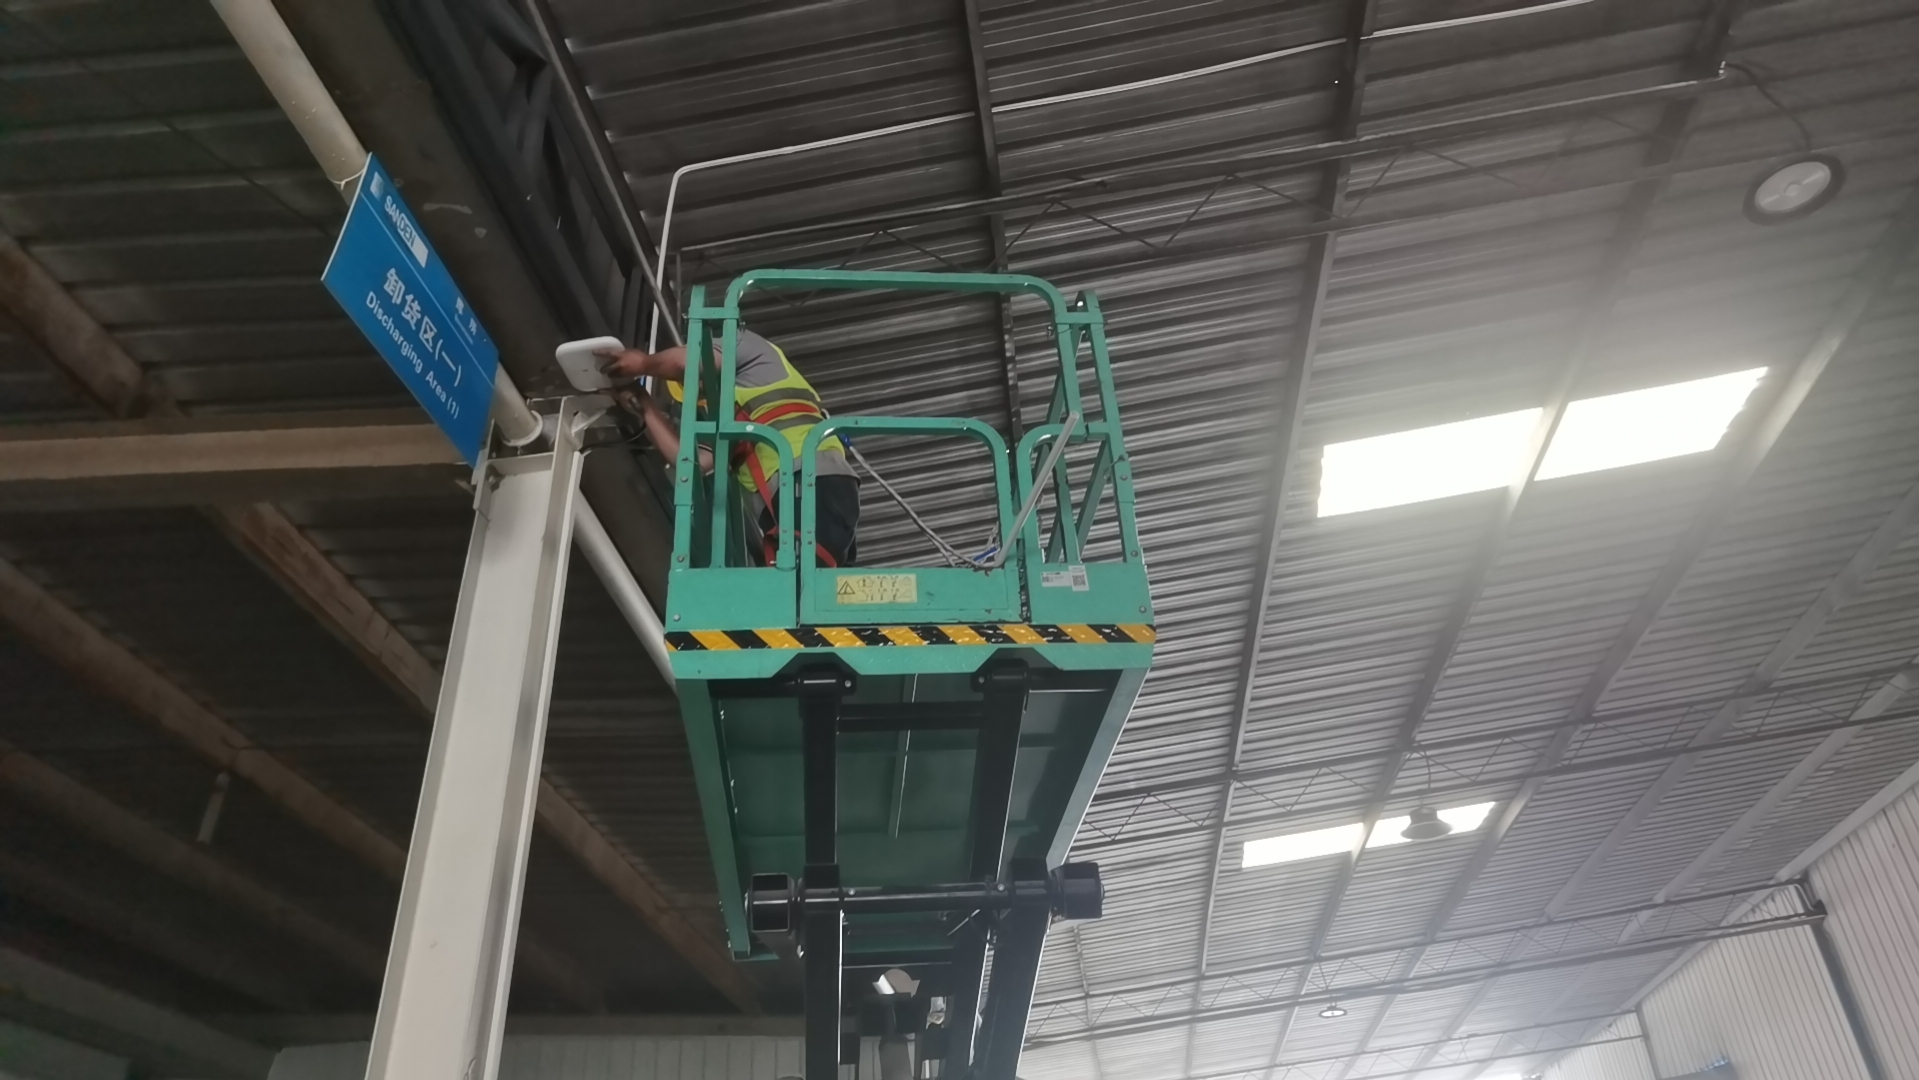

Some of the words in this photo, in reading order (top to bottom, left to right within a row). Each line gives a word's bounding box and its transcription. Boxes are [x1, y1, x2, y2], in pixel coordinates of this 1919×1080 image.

[384, 195, 416, 248] SANDEN
[366, 291, 423, 374] Discharging
[425, 370, 447, 402] Area
[447, 397, 460, 420] (1)
